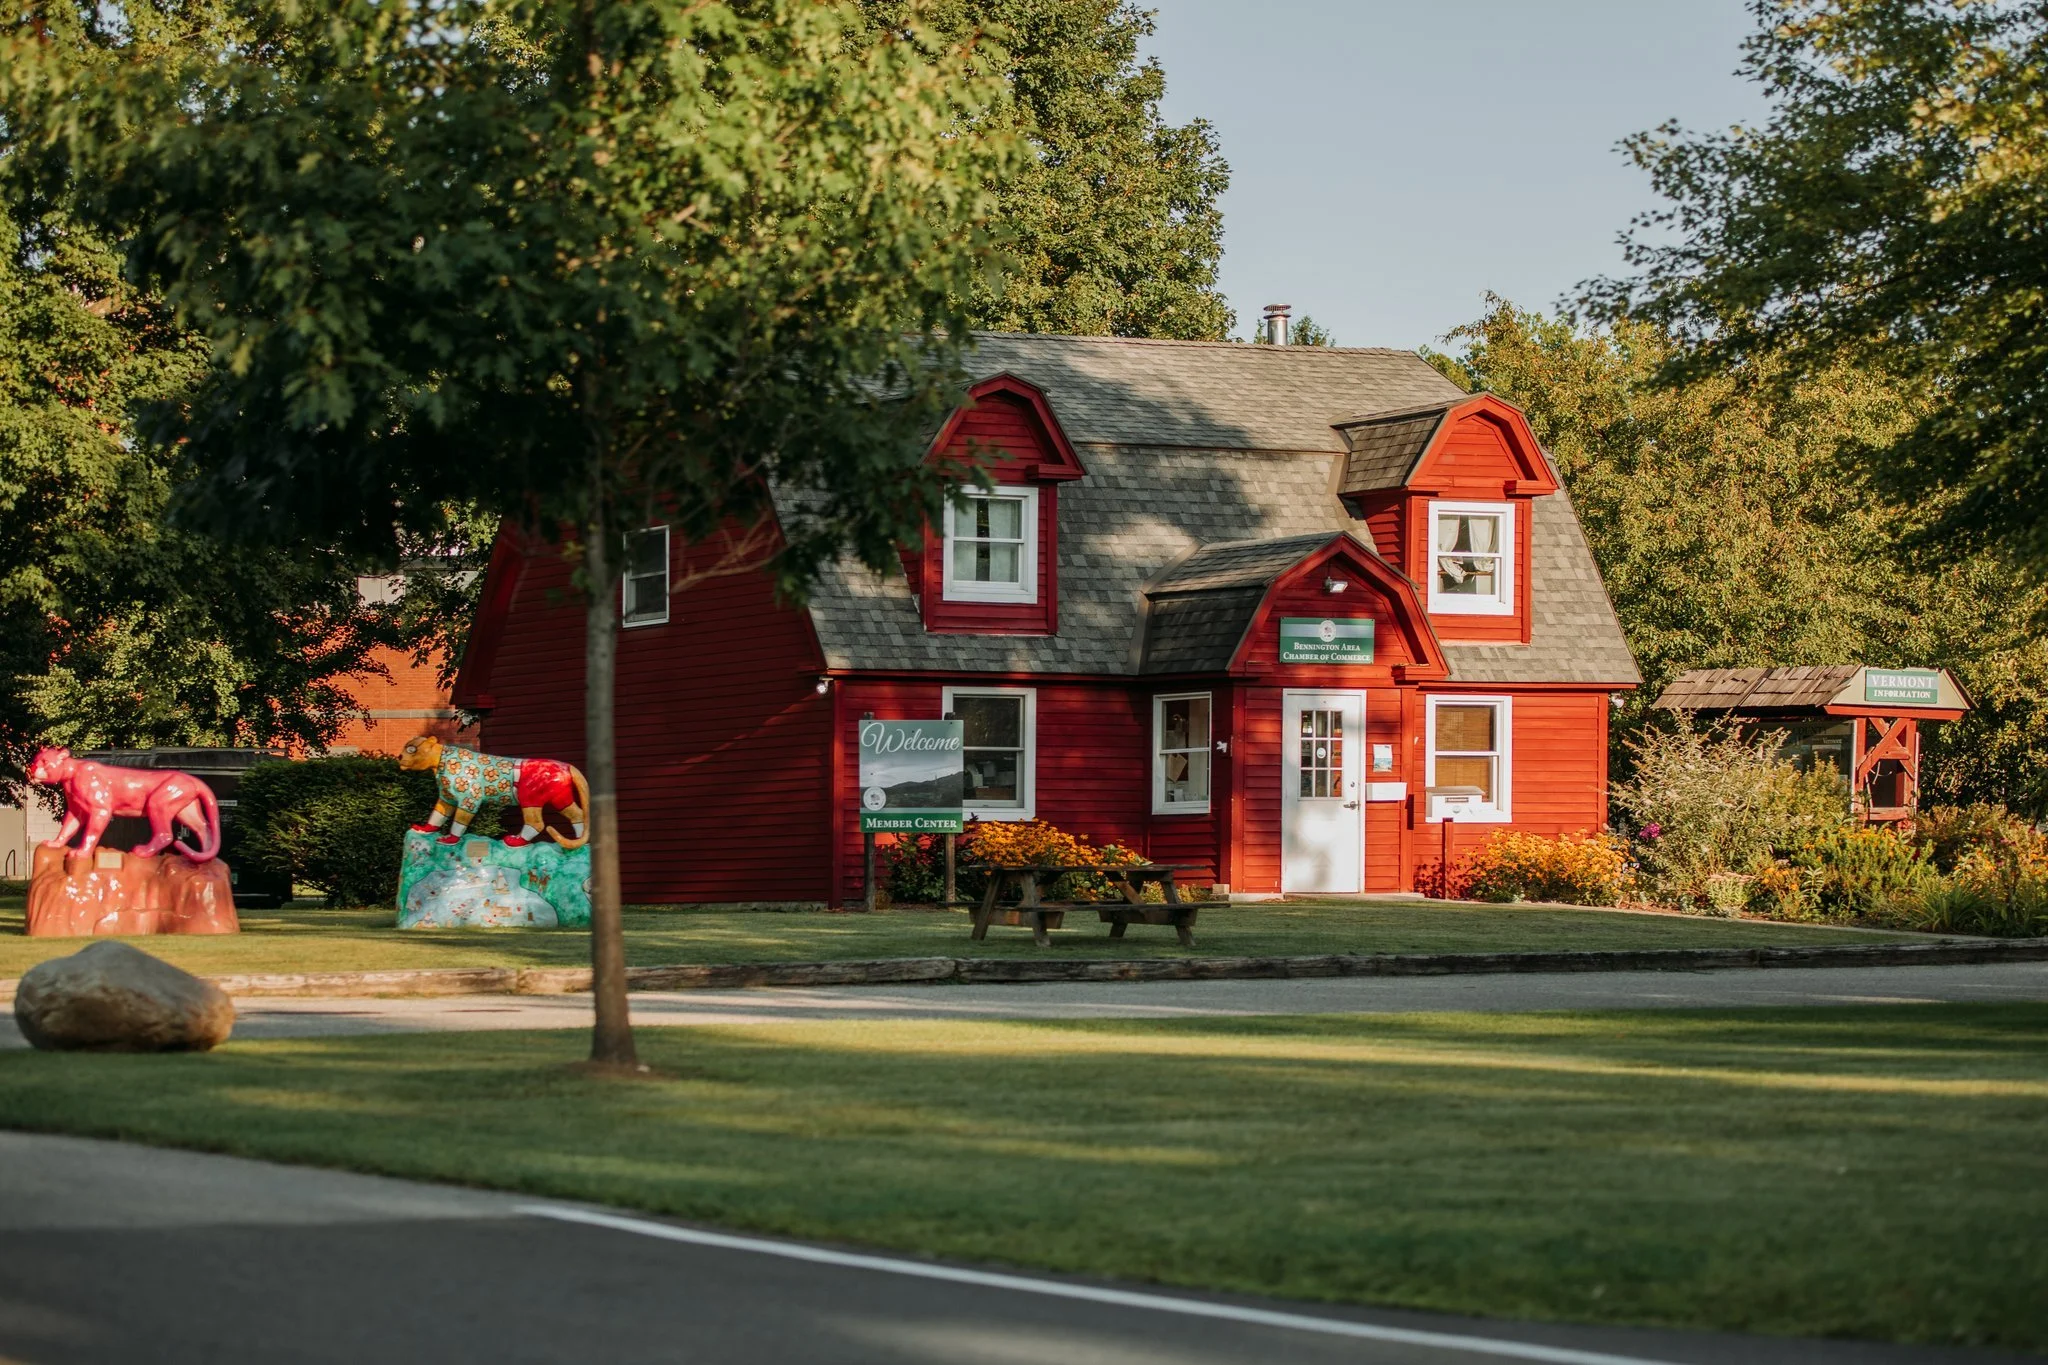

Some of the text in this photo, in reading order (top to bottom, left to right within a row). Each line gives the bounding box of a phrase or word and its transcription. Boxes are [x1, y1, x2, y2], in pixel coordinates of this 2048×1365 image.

[1294, 642, 1360, 651] BENNINGTON AREA
[1283, 651, 1319, 660] CHAMBER
[1330, 652, 1371, 661] COMMERCE
[1871, 675, 1932, 688] VERMONT
[1873, 689, 1931, 699] INFORMATION
[861, 722, 960, 754] Welcome
[866, 817, 957, 829] MEMBER CENTER
